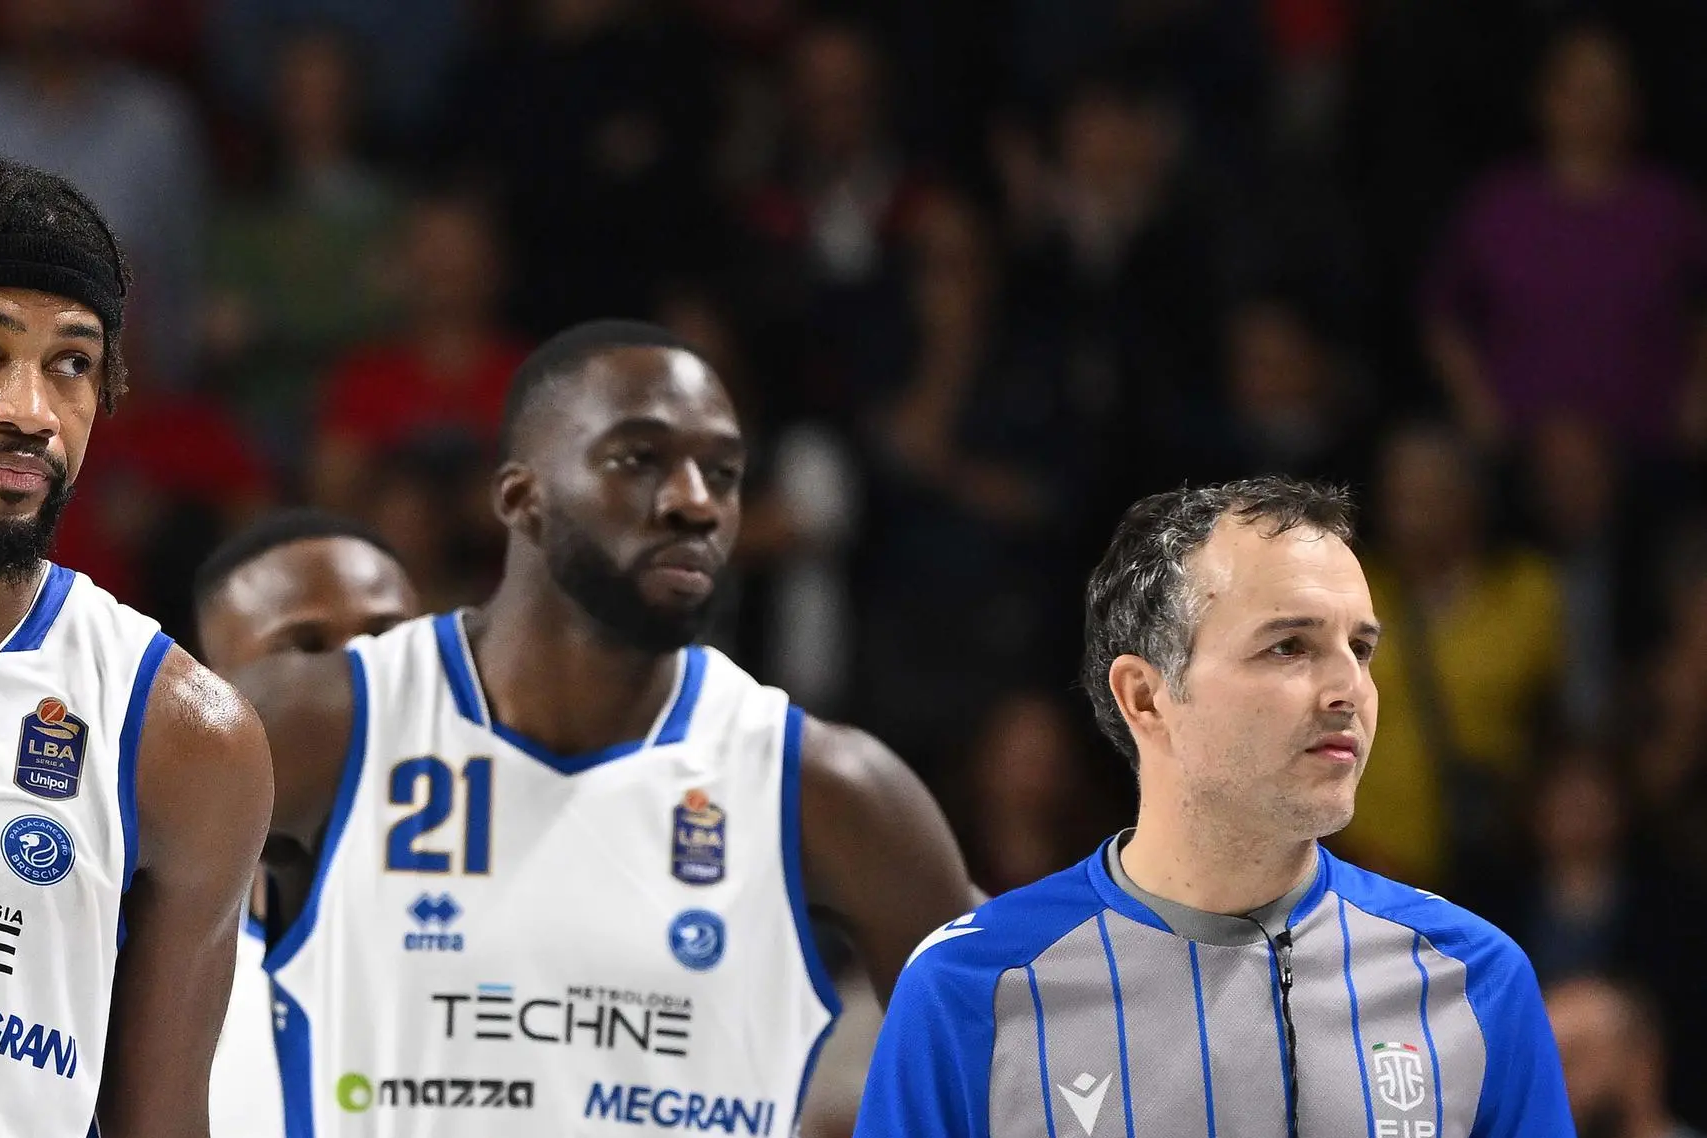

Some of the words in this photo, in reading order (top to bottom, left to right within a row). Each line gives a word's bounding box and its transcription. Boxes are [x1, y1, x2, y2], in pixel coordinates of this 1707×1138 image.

[28, 739, 75, 762] LBA
[35, 758, 57, 767] SERIE
[30, 772, 68, 790] Unipol
[382, 754, 494, 876] 21
[9, 821, 68, 856] PALLACANESTRO
[11, 854, 60, 879] BRESCIA
[432, 983, 692, 1057] TECHNE
[378, 1079, 535, 1109] mazza
[584, 1083, 775, 1138] MEGRANI
